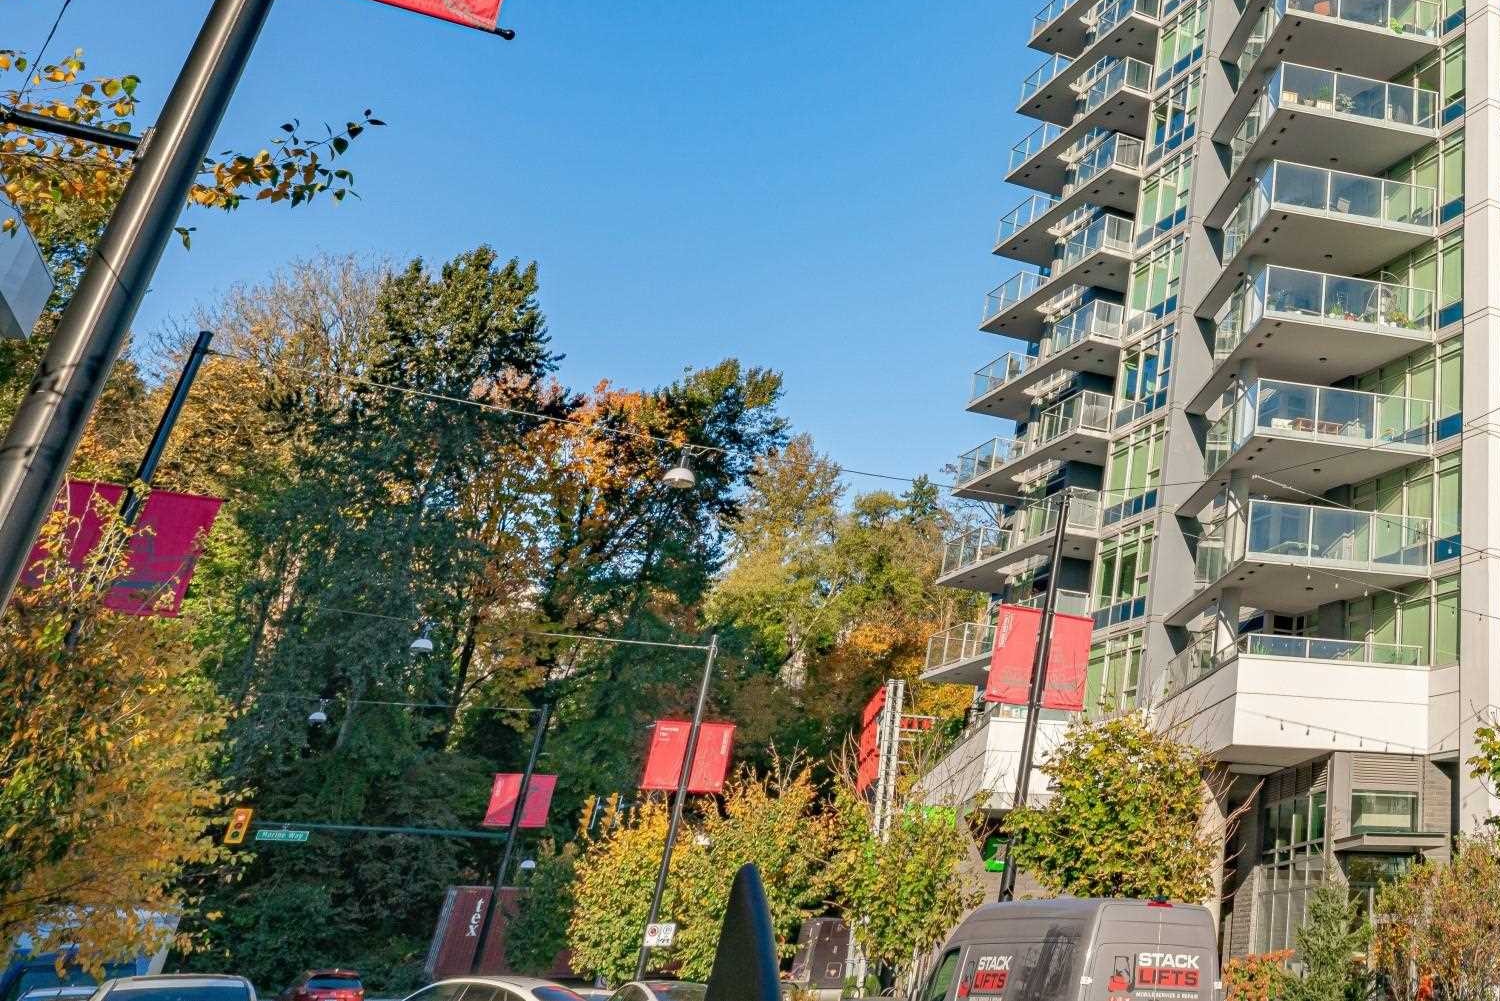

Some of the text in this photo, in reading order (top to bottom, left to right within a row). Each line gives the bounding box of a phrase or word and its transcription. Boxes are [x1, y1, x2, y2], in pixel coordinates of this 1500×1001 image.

[978, 955, 1012, 970] STACK
[1137, 952, 1200, 970] STACK
[973, 973, 1007, 990] LIFTS
[1139, 968, 1199, 987] LIFTS
